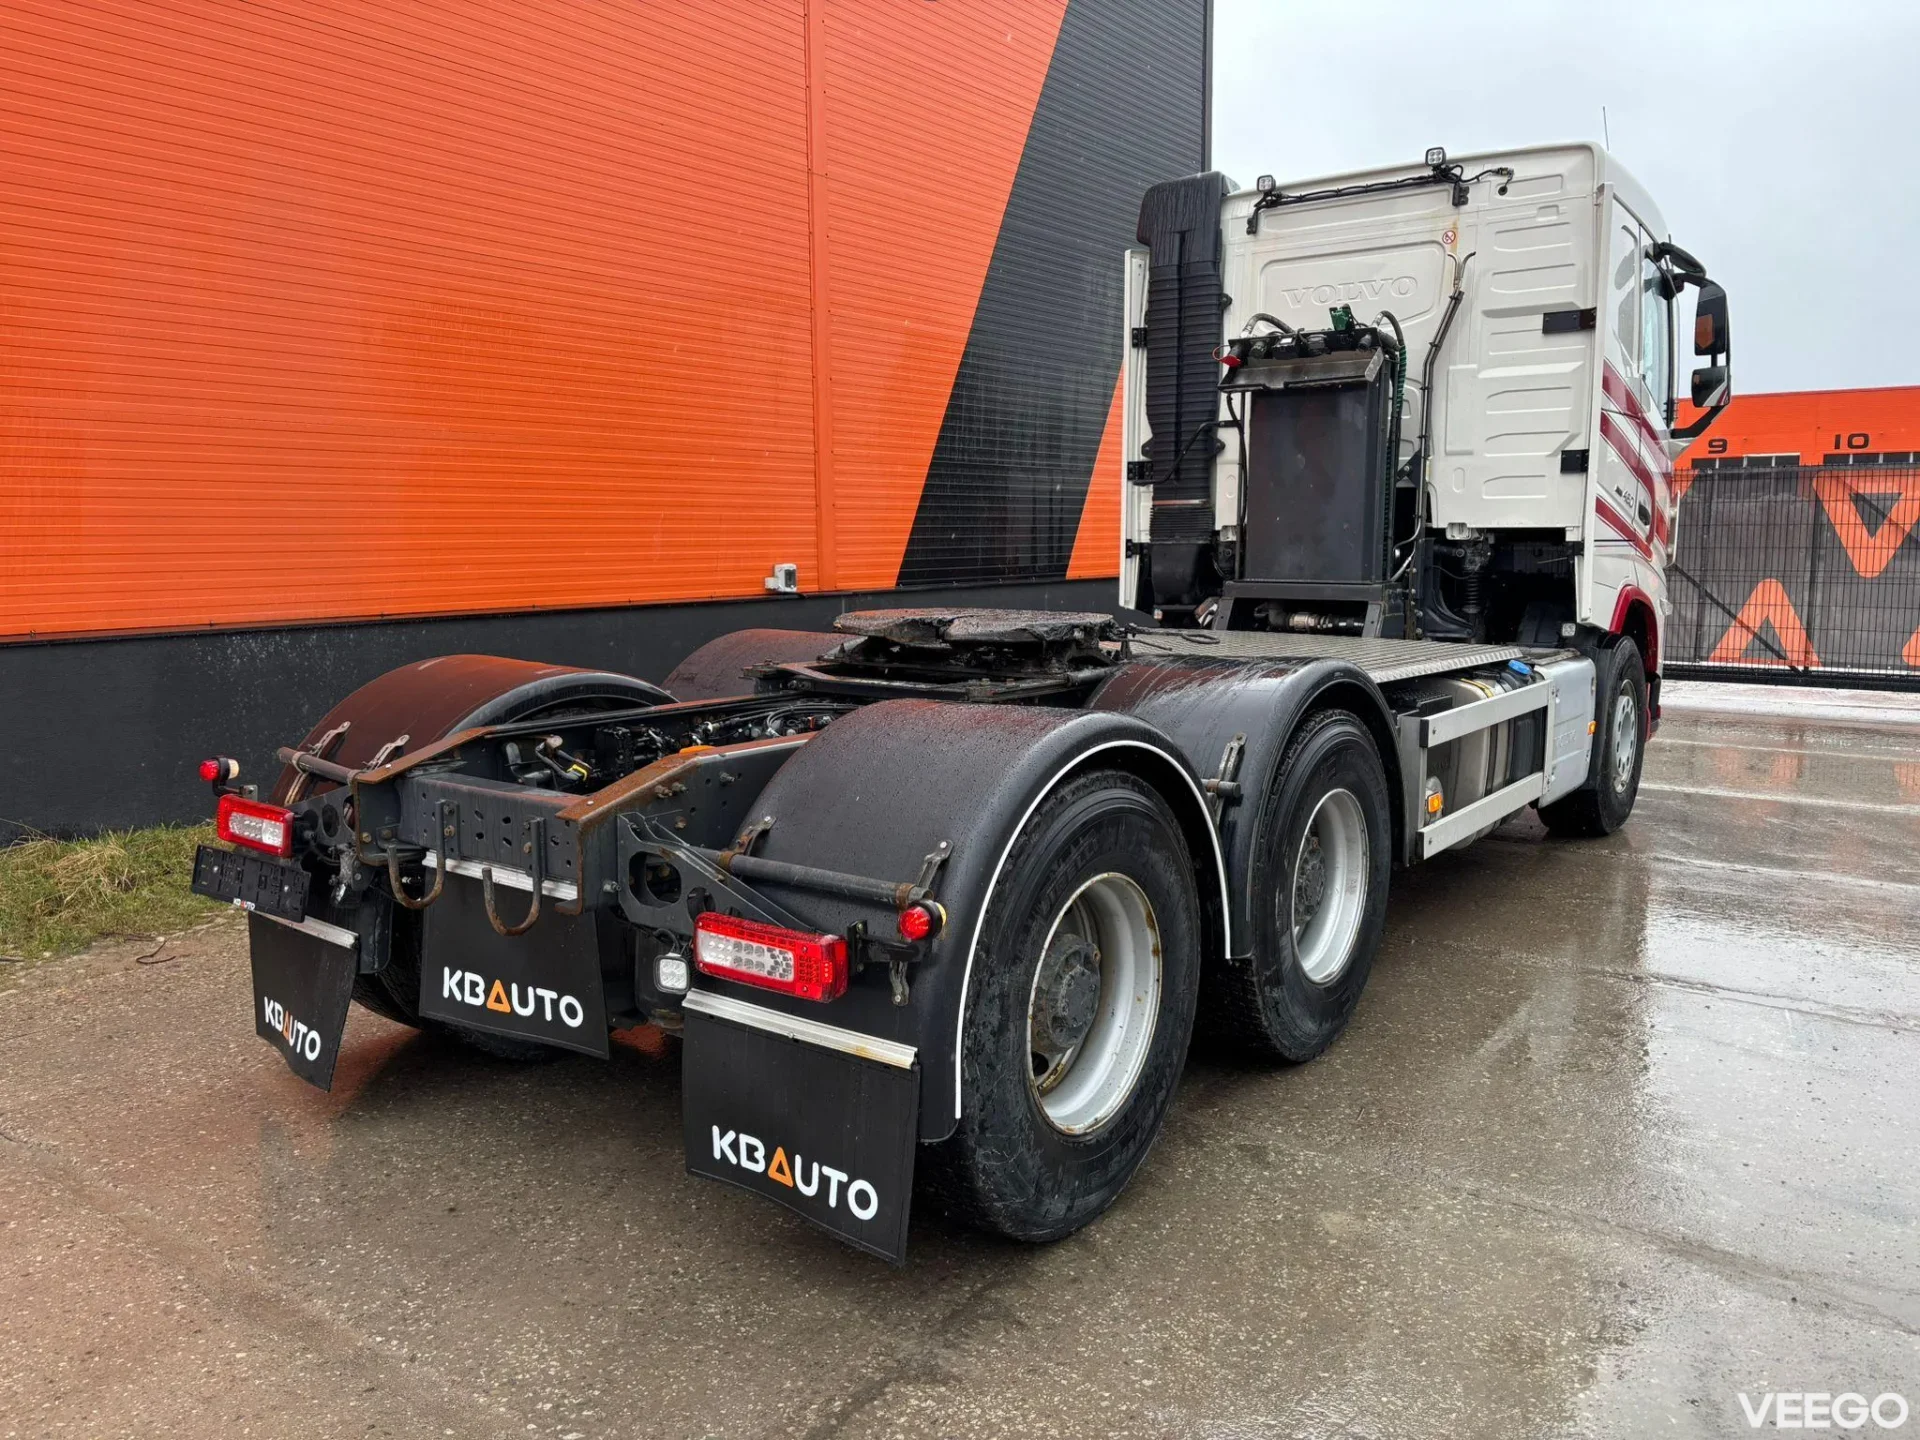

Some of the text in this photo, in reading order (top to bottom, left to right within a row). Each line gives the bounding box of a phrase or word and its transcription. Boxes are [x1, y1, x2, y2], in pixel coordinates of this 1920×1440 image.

[1281, 276, 1418, 308] VOLVO
[1707, 438, 1728, 454] 9
[1834, 432, 1870, 450] 10
[443, 966, 583, 1028] KBAUTO
[263, 996, 322, 1061] KBAUTO
[712, 1124, 880, 1221] KBAUTO
